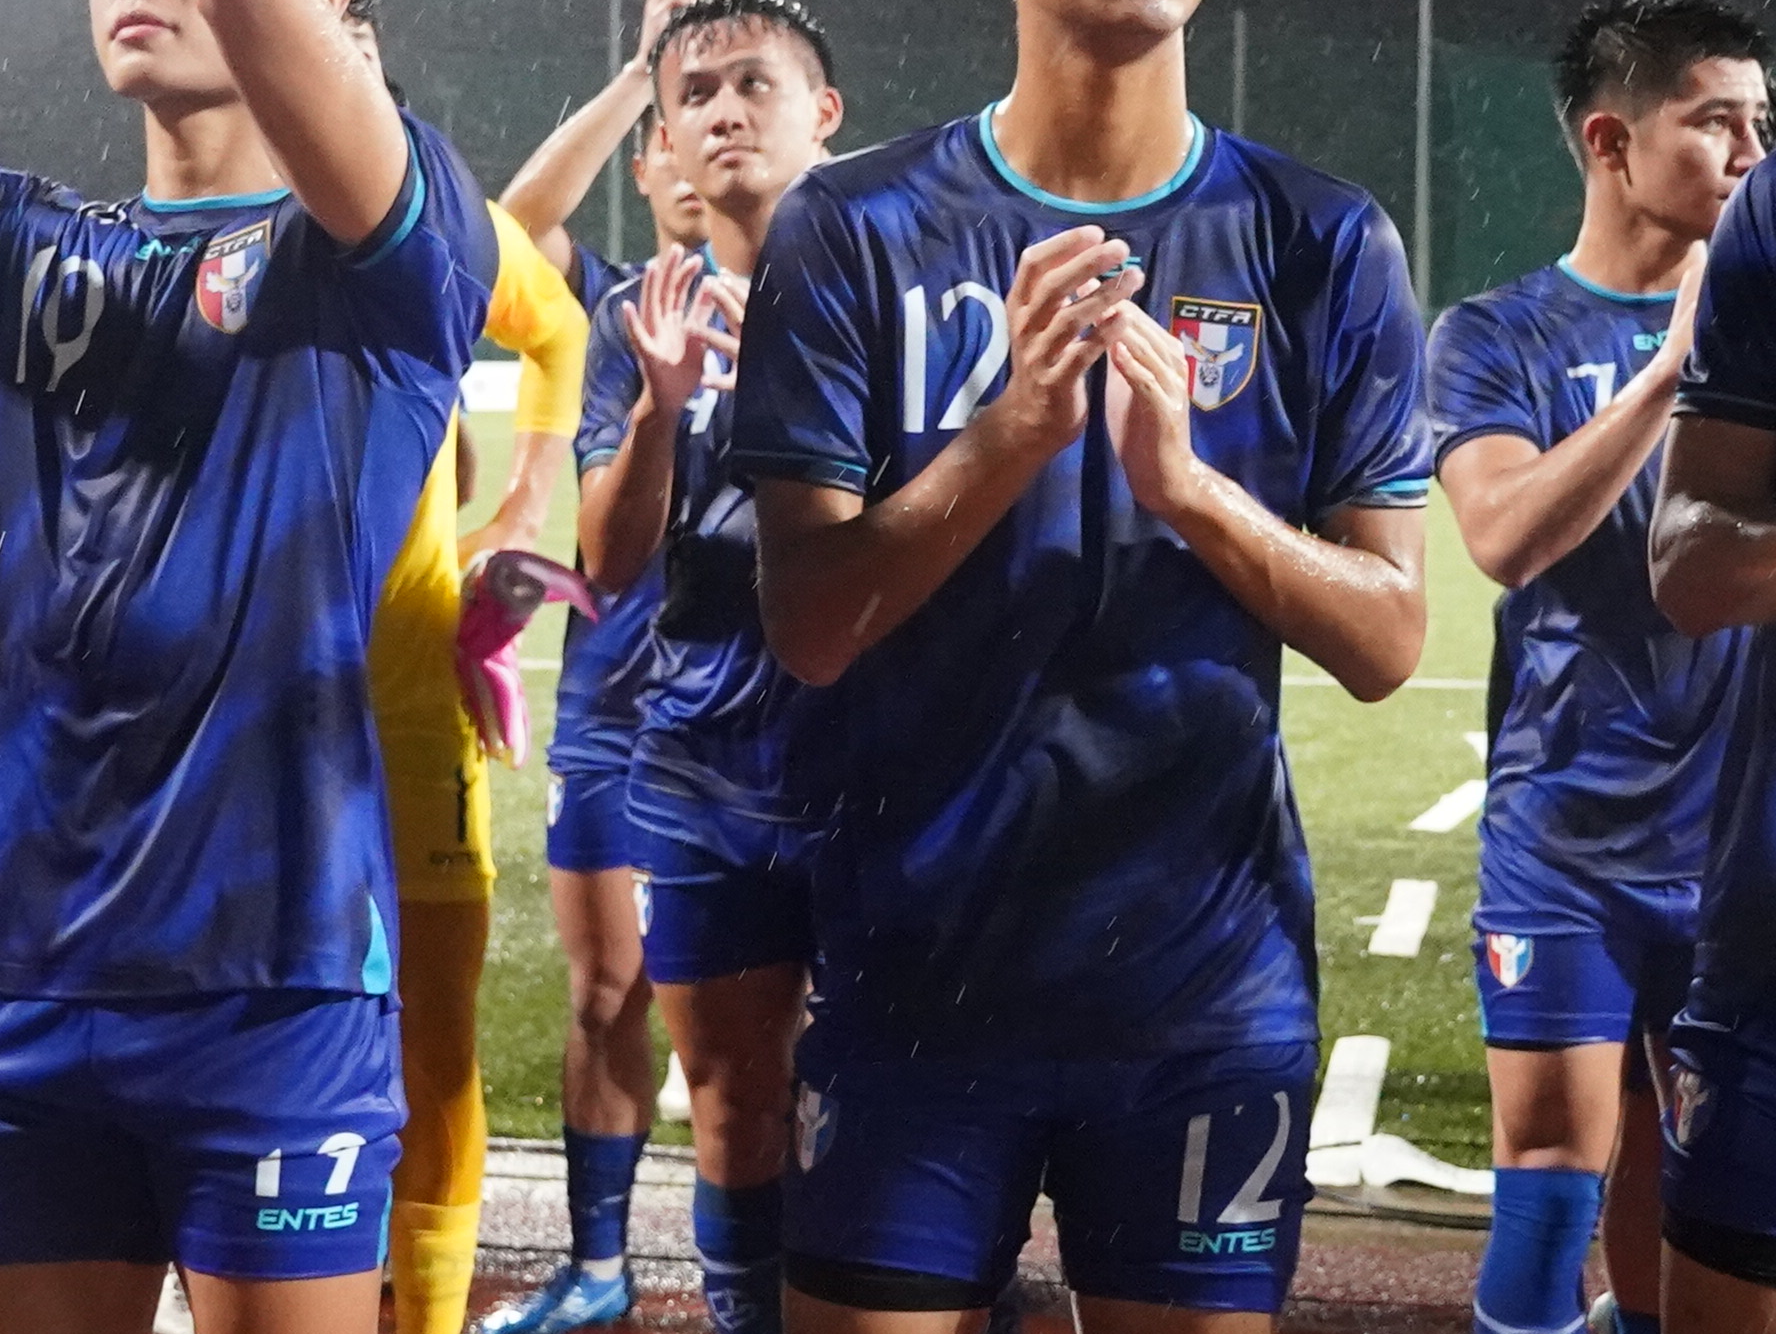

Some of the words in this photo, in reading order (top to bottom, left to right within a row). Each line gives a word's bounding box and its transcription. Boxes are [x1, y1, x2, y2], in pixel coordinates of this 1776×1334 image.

[1179, 304, 1253, 324] CTFA
[903, 280, 1010, 434] 12
[1177, 1091, 1291, 1224] 12
[256, 1202, 360, 1231] ENTES
[1179, 1228, 1277, 1254] ENTES
